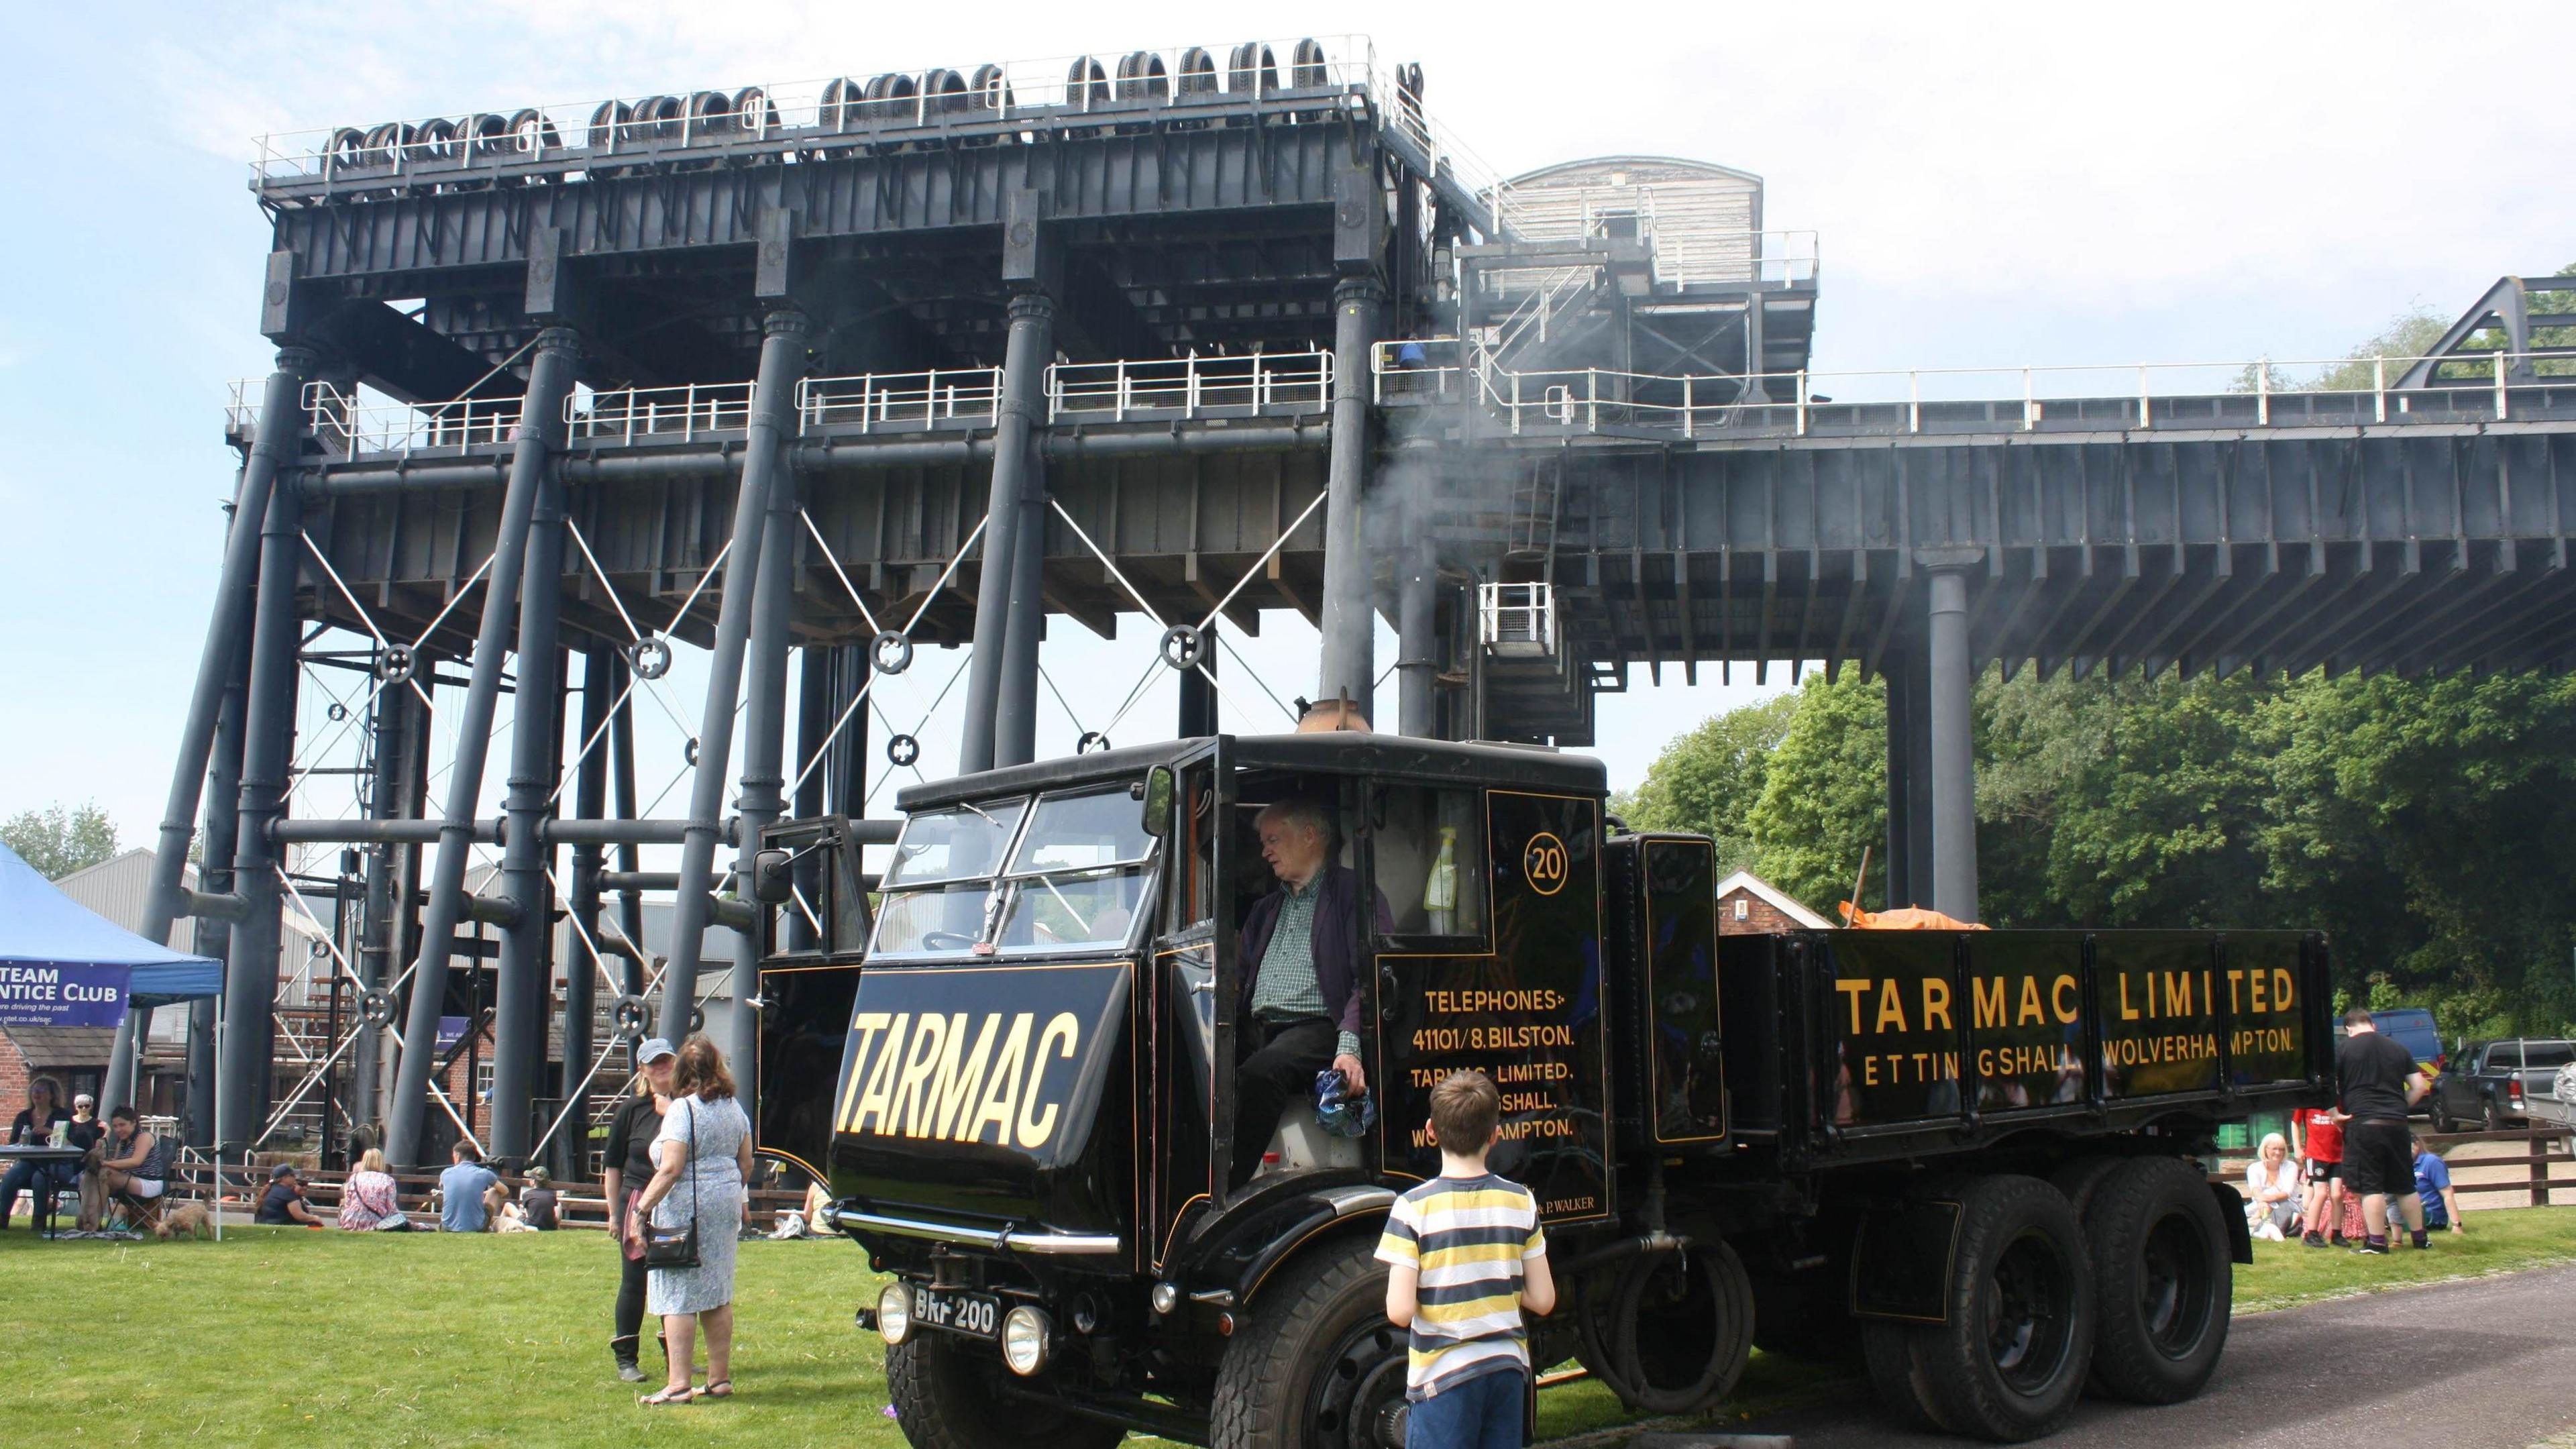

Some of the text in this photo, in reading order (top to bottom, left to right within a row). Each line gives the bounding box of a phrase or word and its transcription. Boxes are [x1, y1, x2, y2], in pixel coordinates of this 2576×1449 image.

[1533, 847, 1561, 879] 20
[0, 967, 59, 984] TEAM
[11, 1004, 37, 1012] driving
[1835, 968, 2294, 1035] TARMAC LIMITED
[1488, 1025, 1574, 1048] BILSTON.
[1865, 1027, 2294, 1085] ETTINGSHALL. WOLVERHAMPTON.
[836, 1012, 1079, 1149] TARMAC
[1554, 1196, 1595, 1212] WALKER
[955, 1296, 994, 1334] 200
